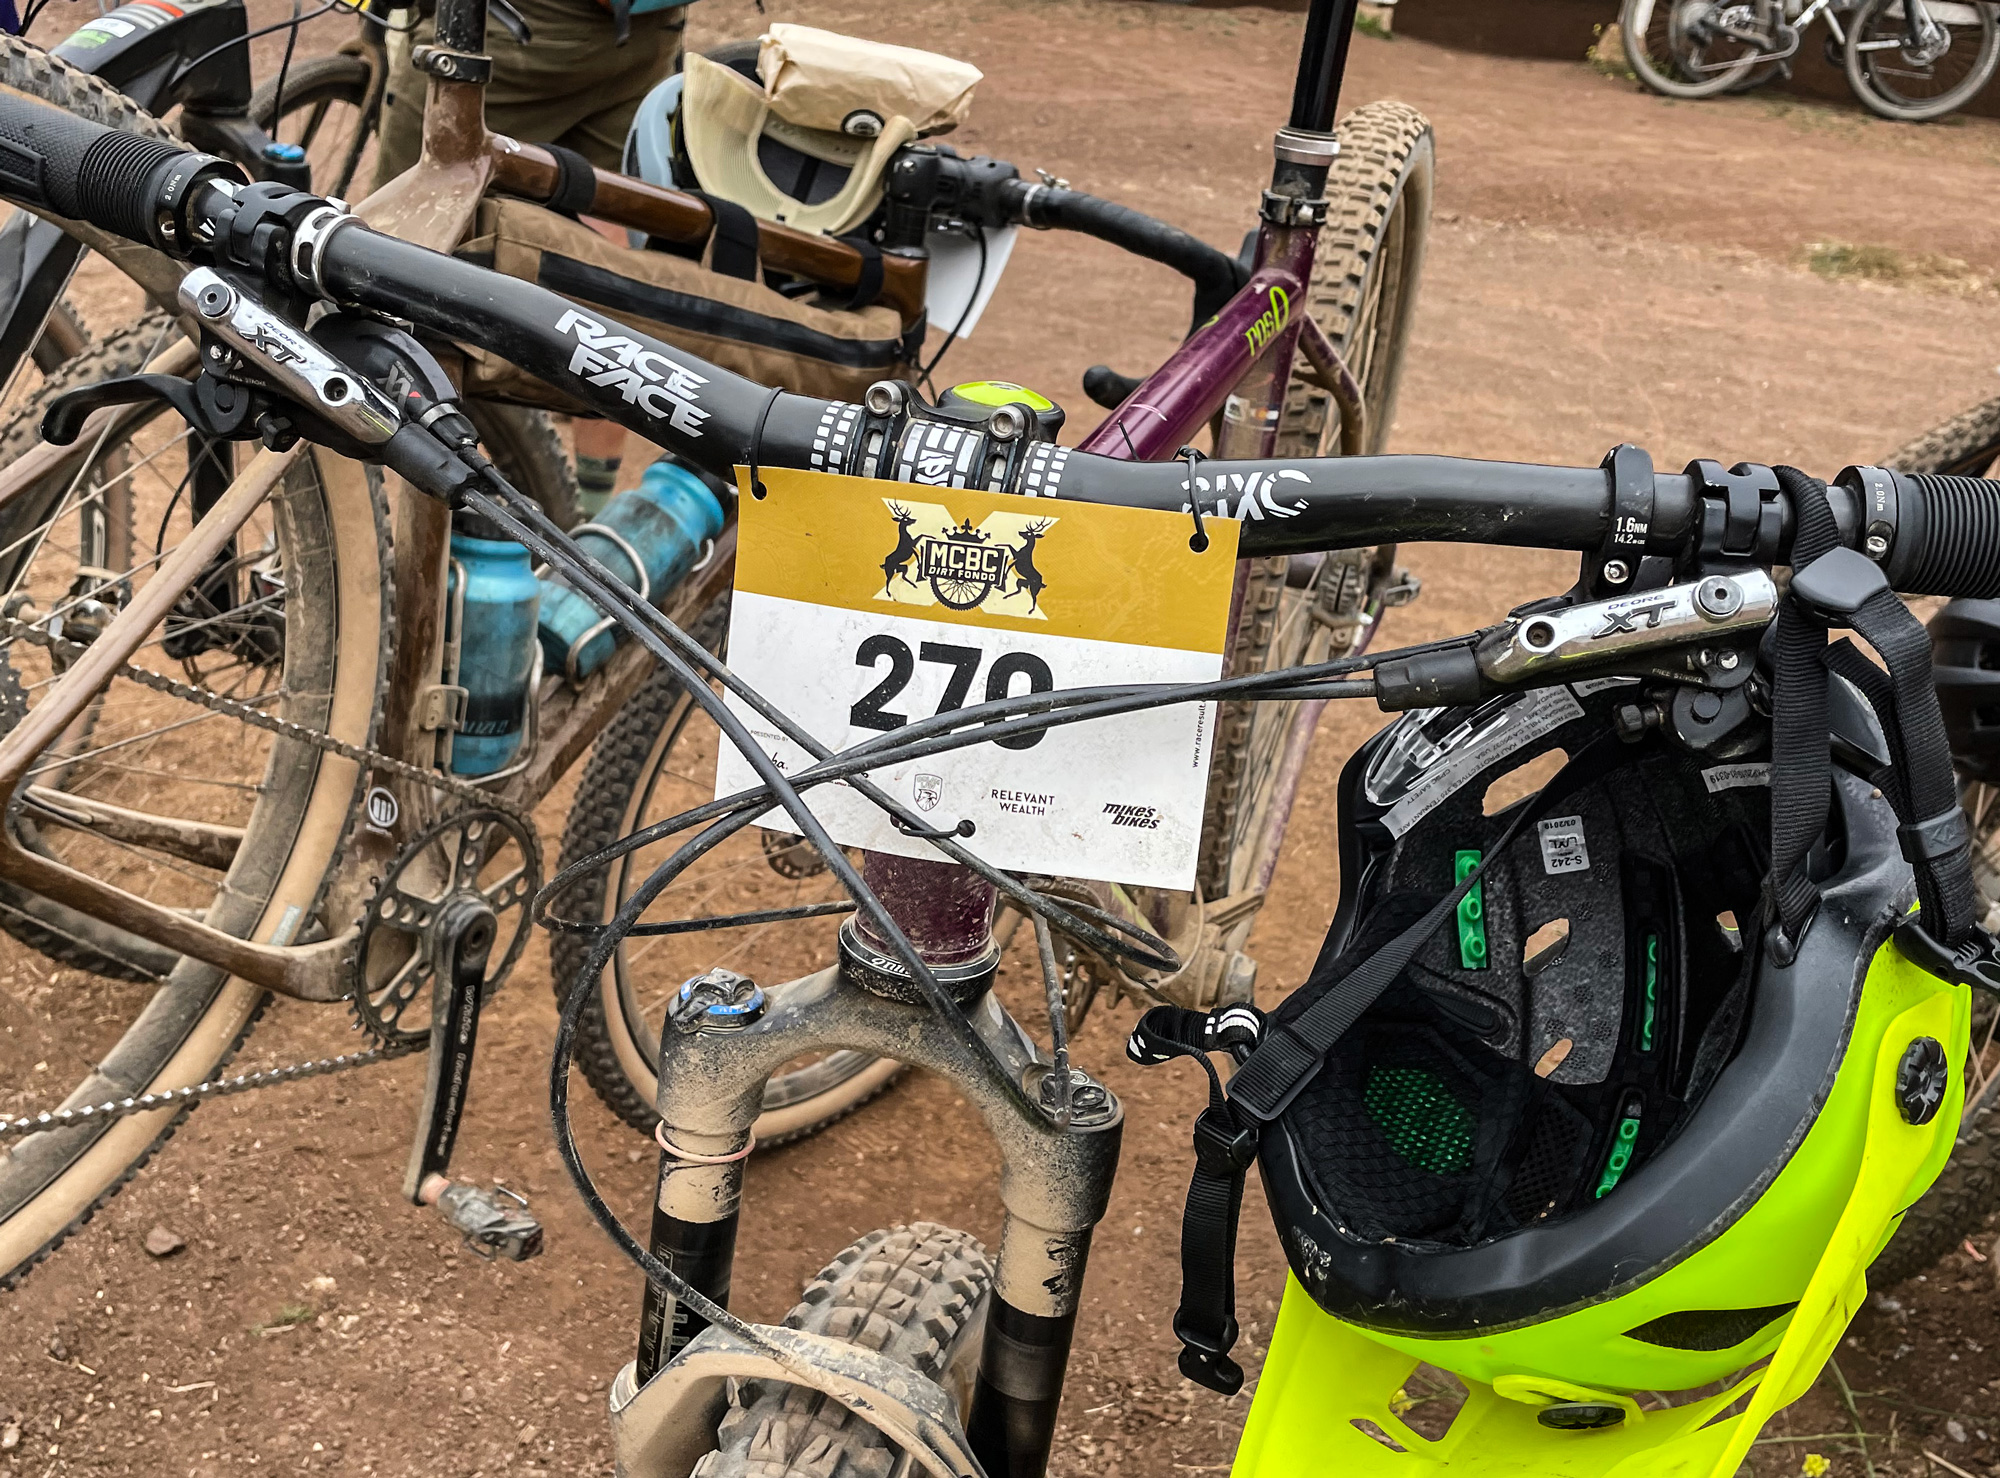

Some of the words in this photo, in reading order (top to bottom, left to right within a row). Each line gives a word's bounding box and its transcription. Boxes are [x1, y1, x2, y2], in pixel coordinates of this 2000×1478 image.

[239, 324, 307, 365] XT
[554, 309, 710, 400] RACE
[568, 343, 712, 438] FACE
[1874, 482, 1886, 512] 2.0Nm
[929, 542, 999, 573] MCBC
[928, 566, 955, 577] DIRT
[957, 569, 996, 582] FONDO
[1608, 594, 1665, 610] DEORE
[1591, 600, 1679, 639] XT
[850, 634, 1054, 750] 270
[991, 789, 1055, 805] RELEVANT
[1000, 802, 1045, 816] WEALTH
[1410, 797, 1440, 822] TENNANT
[1397, 821, 1411, 833] AVE
[1551, 855, 1582, 868] S-242
